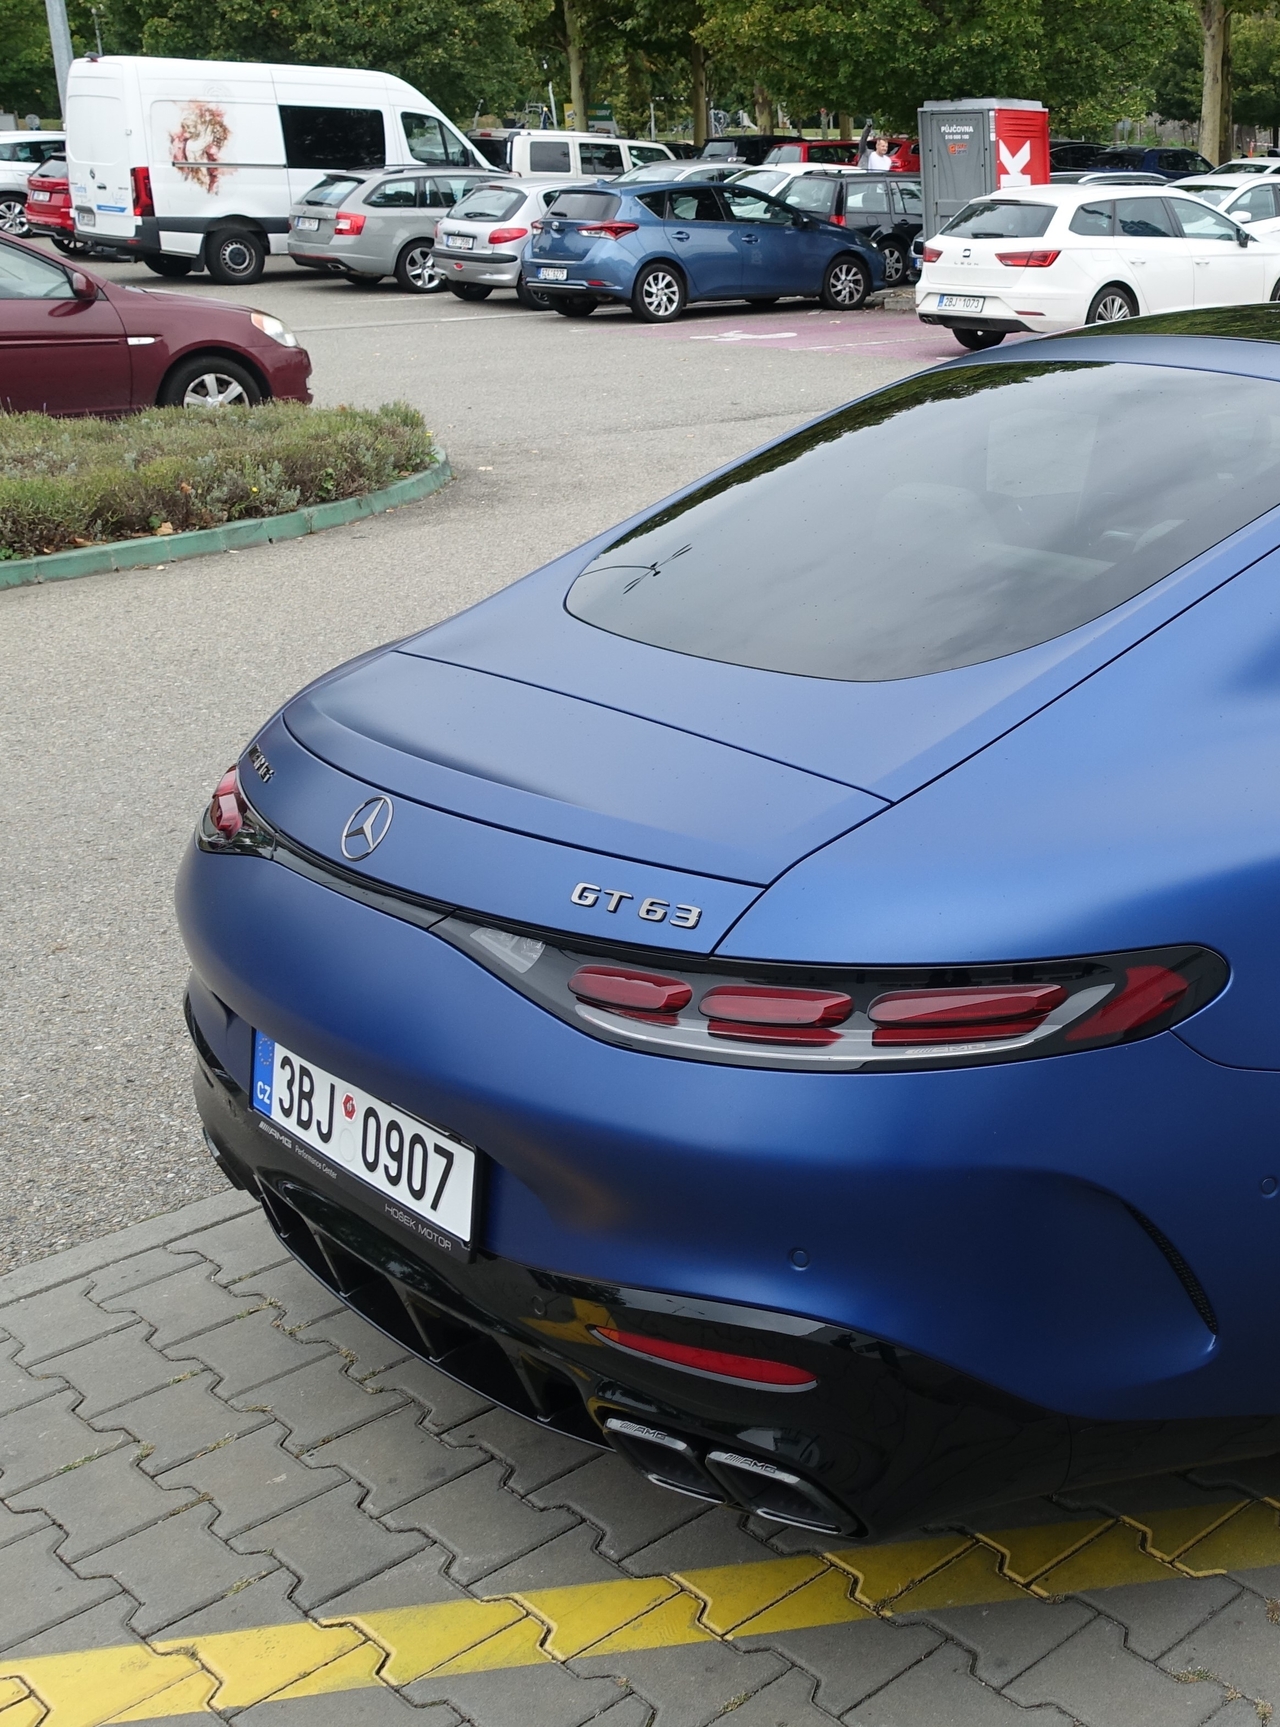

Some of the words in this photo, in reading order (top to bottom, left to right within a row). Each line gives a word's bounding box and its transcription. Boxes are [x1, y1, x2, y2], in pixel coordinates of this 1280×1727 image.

[940, 124, 974, 133] PŮJČOVNA
[961, 298, 980, 309] 1073
[570, 882, 634, 914] GT
[638, 897, 702, 929] 63
[257, 1081, 271, 1105] CZ
[278, 1055, 336, 1144] 3BJ
[361, 1106, 455, 1212] 0907
[294, 1144, 322, 1170] Performance
[418, 1223, 452, 1251] MOTOR
